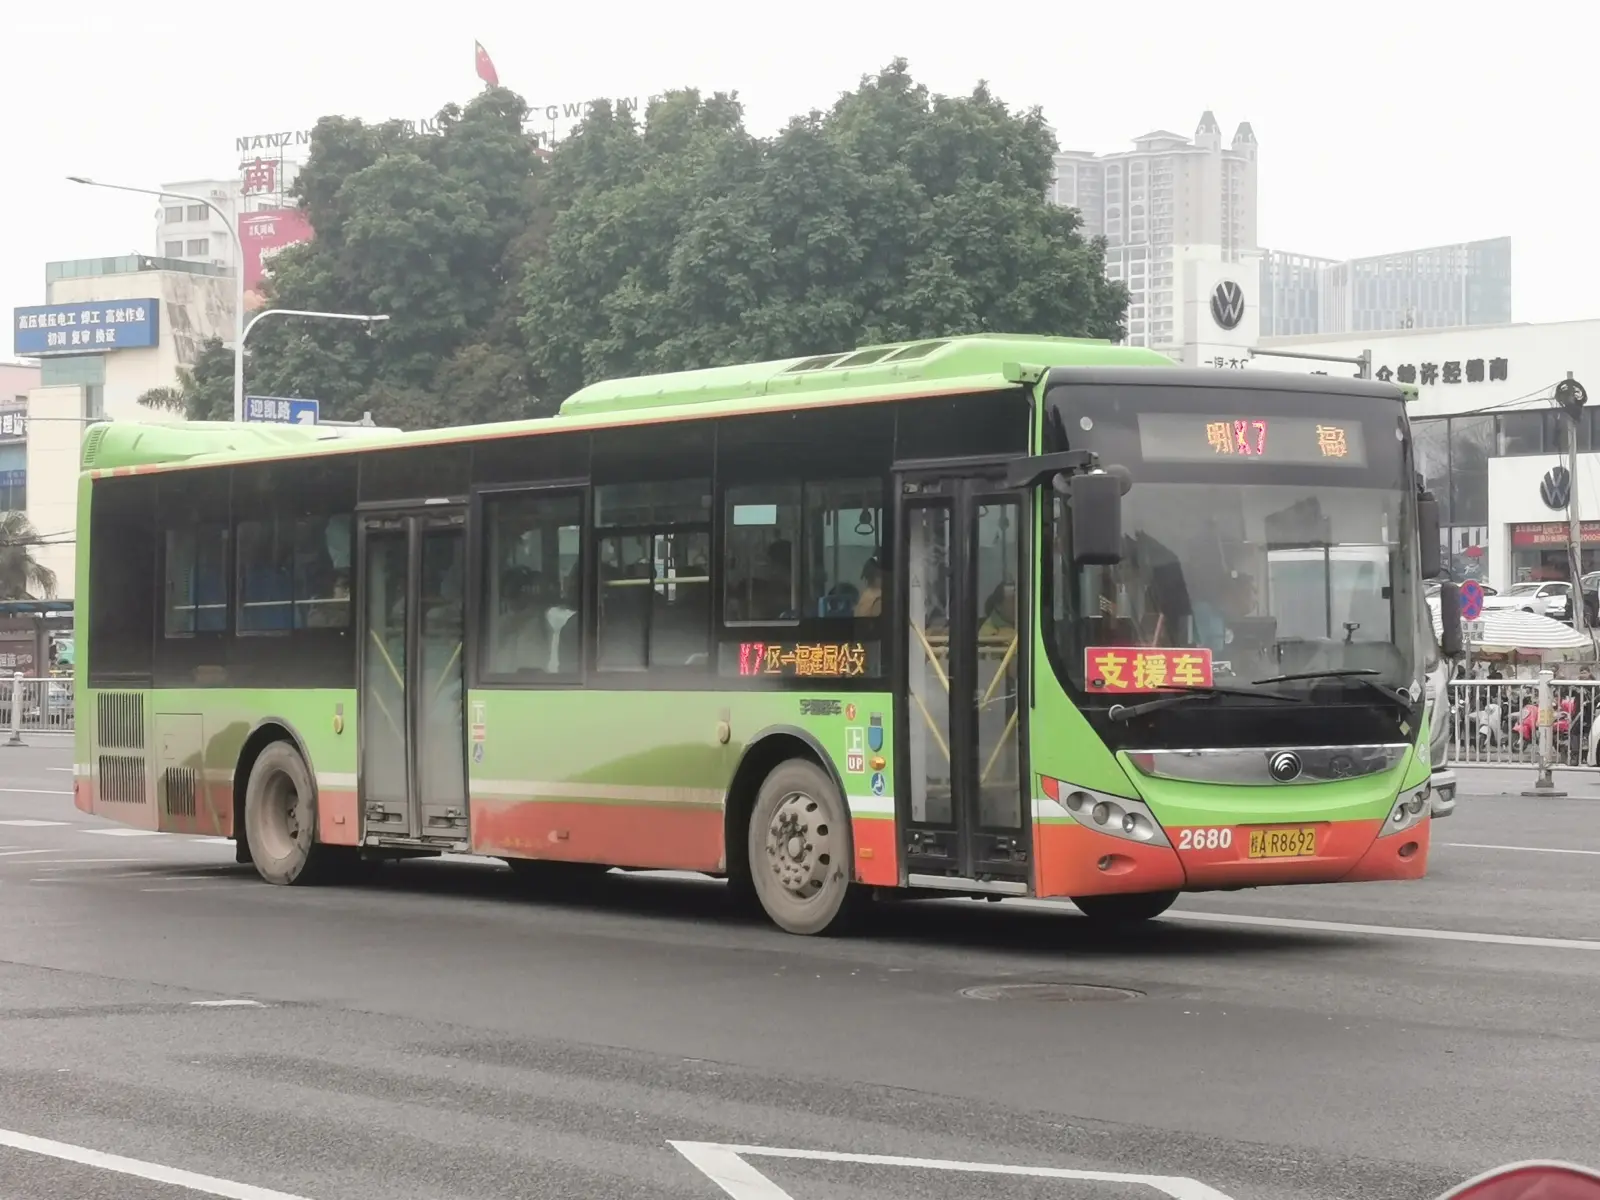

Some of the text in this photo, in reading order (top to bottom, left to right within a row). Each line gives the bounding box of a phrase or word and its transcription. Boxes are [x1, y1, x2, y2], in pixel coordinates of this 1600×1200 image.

[239, 156, 279, 195] 南
[249, 399, 291, 420] 迎凯路
[1095, 652, 1205, 688] 支援车
[848, 756, 863, 770] UP
[1179, 828, 1232, 850] 2680
